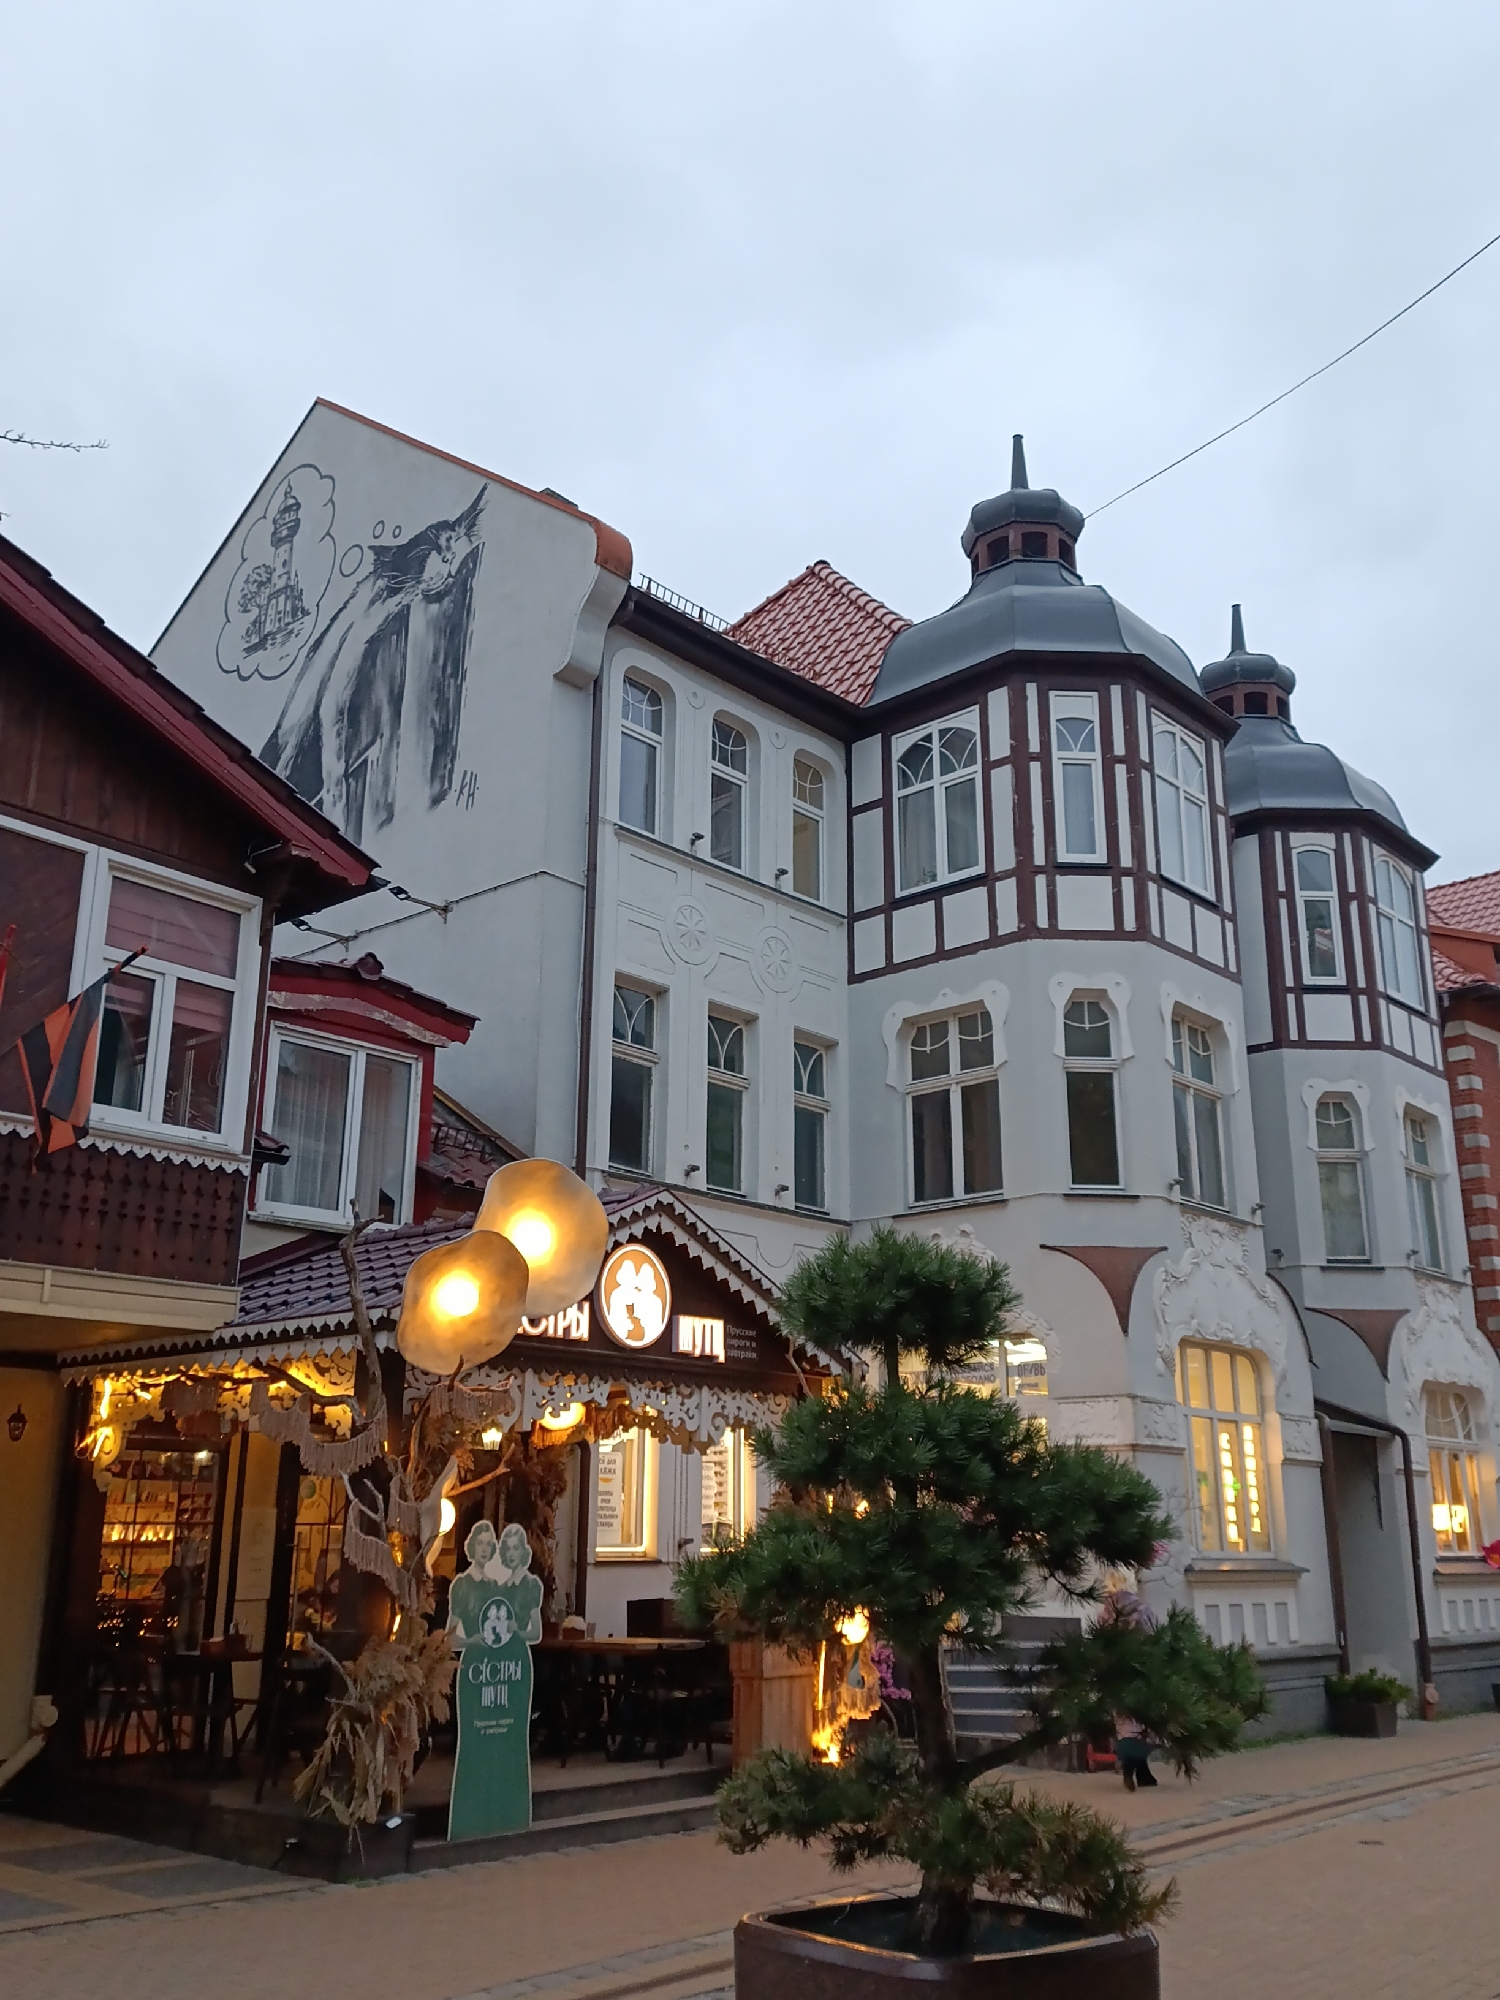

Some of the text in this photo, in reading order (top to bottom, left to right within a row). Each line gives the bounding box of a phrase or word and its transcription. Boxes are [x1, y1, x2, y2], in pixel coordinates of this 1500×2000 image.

[726, 1324, 757, 1338] Прусские
[726, 1338, 757, 1348] пироги и
[598, 1456, 606, 1465] СЁ
[599, 1467, 617, 1476] ЛЯЖА
